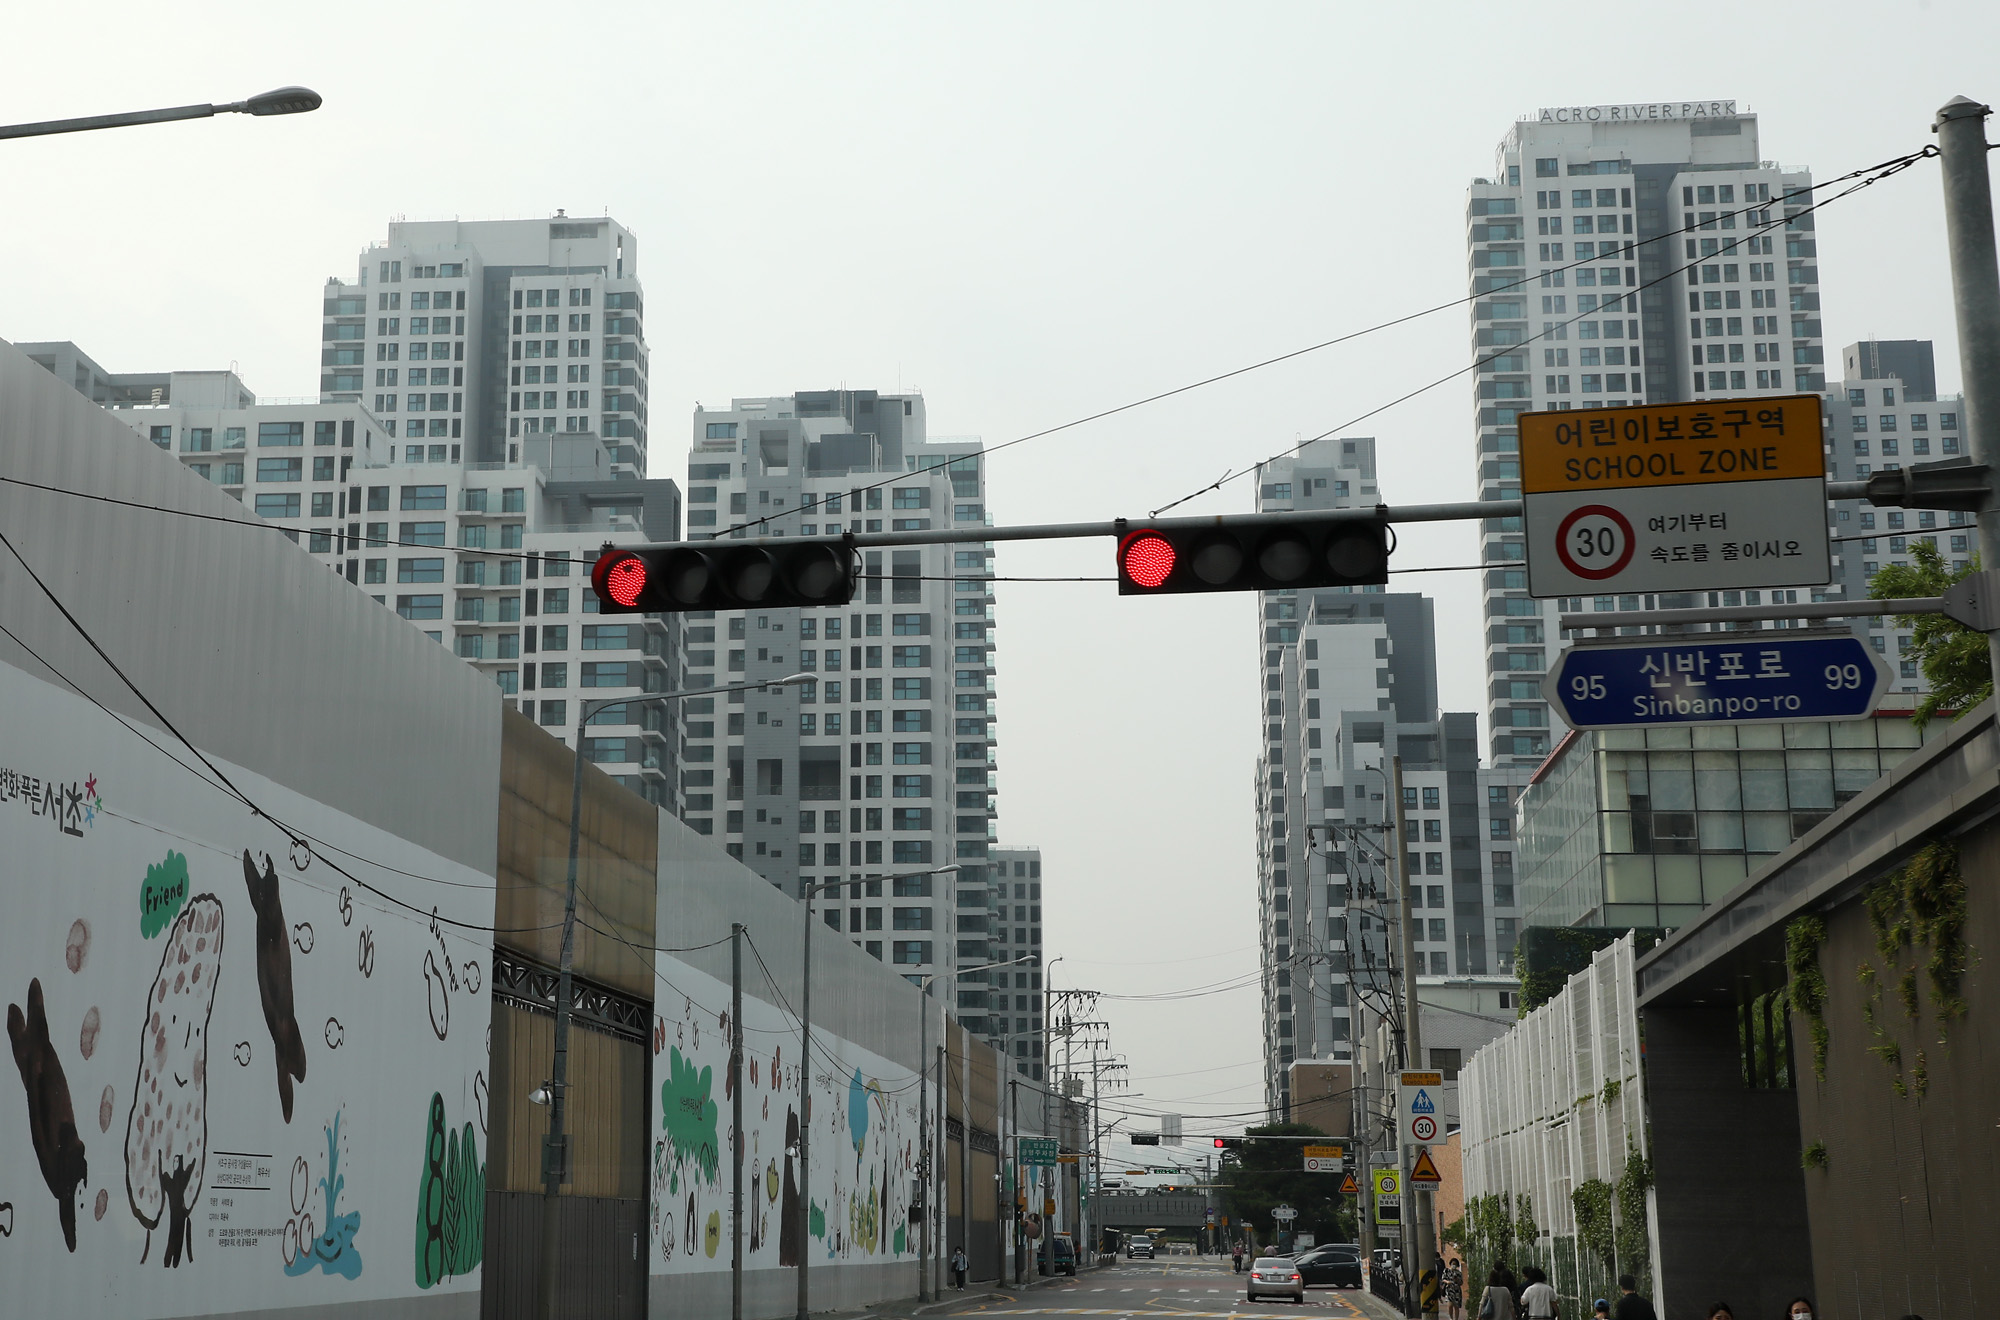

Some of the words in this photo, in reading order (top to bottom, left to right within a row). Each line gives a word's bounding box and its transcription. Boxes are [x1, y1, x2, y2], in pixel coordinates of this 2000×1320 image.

[1541, 107, 1601, 123] ACRO
[1611, 104, 1673, 120] RIVER
[1682, 101, 1736, 118] PARK
[1556, 406, 1785, 448] 어린이보호구역
[1565, 453, 1685, 482] SCHOOL
[1700, 446, 1778, 475] ZONE
[1648, 512, 1727, 534] 여기부터
[1576, 527, 1615, 558] 30
[1650, 544, 1709, 564] 속도를
[1720, 539, 1802, 562] 줄이시오
[1639, 650, 1791, 689] 신반포로
[1824, 663, 1862, 690] 99
[1571, 674, 1607, 701] 95
[1633, 692, 1801, 718] Sinbanpo-ro
[146, 877, 183, 915] Friend
[1417, 1123, 1431, 1134] 30
[1383, 1181, 1393, 1189] 30
